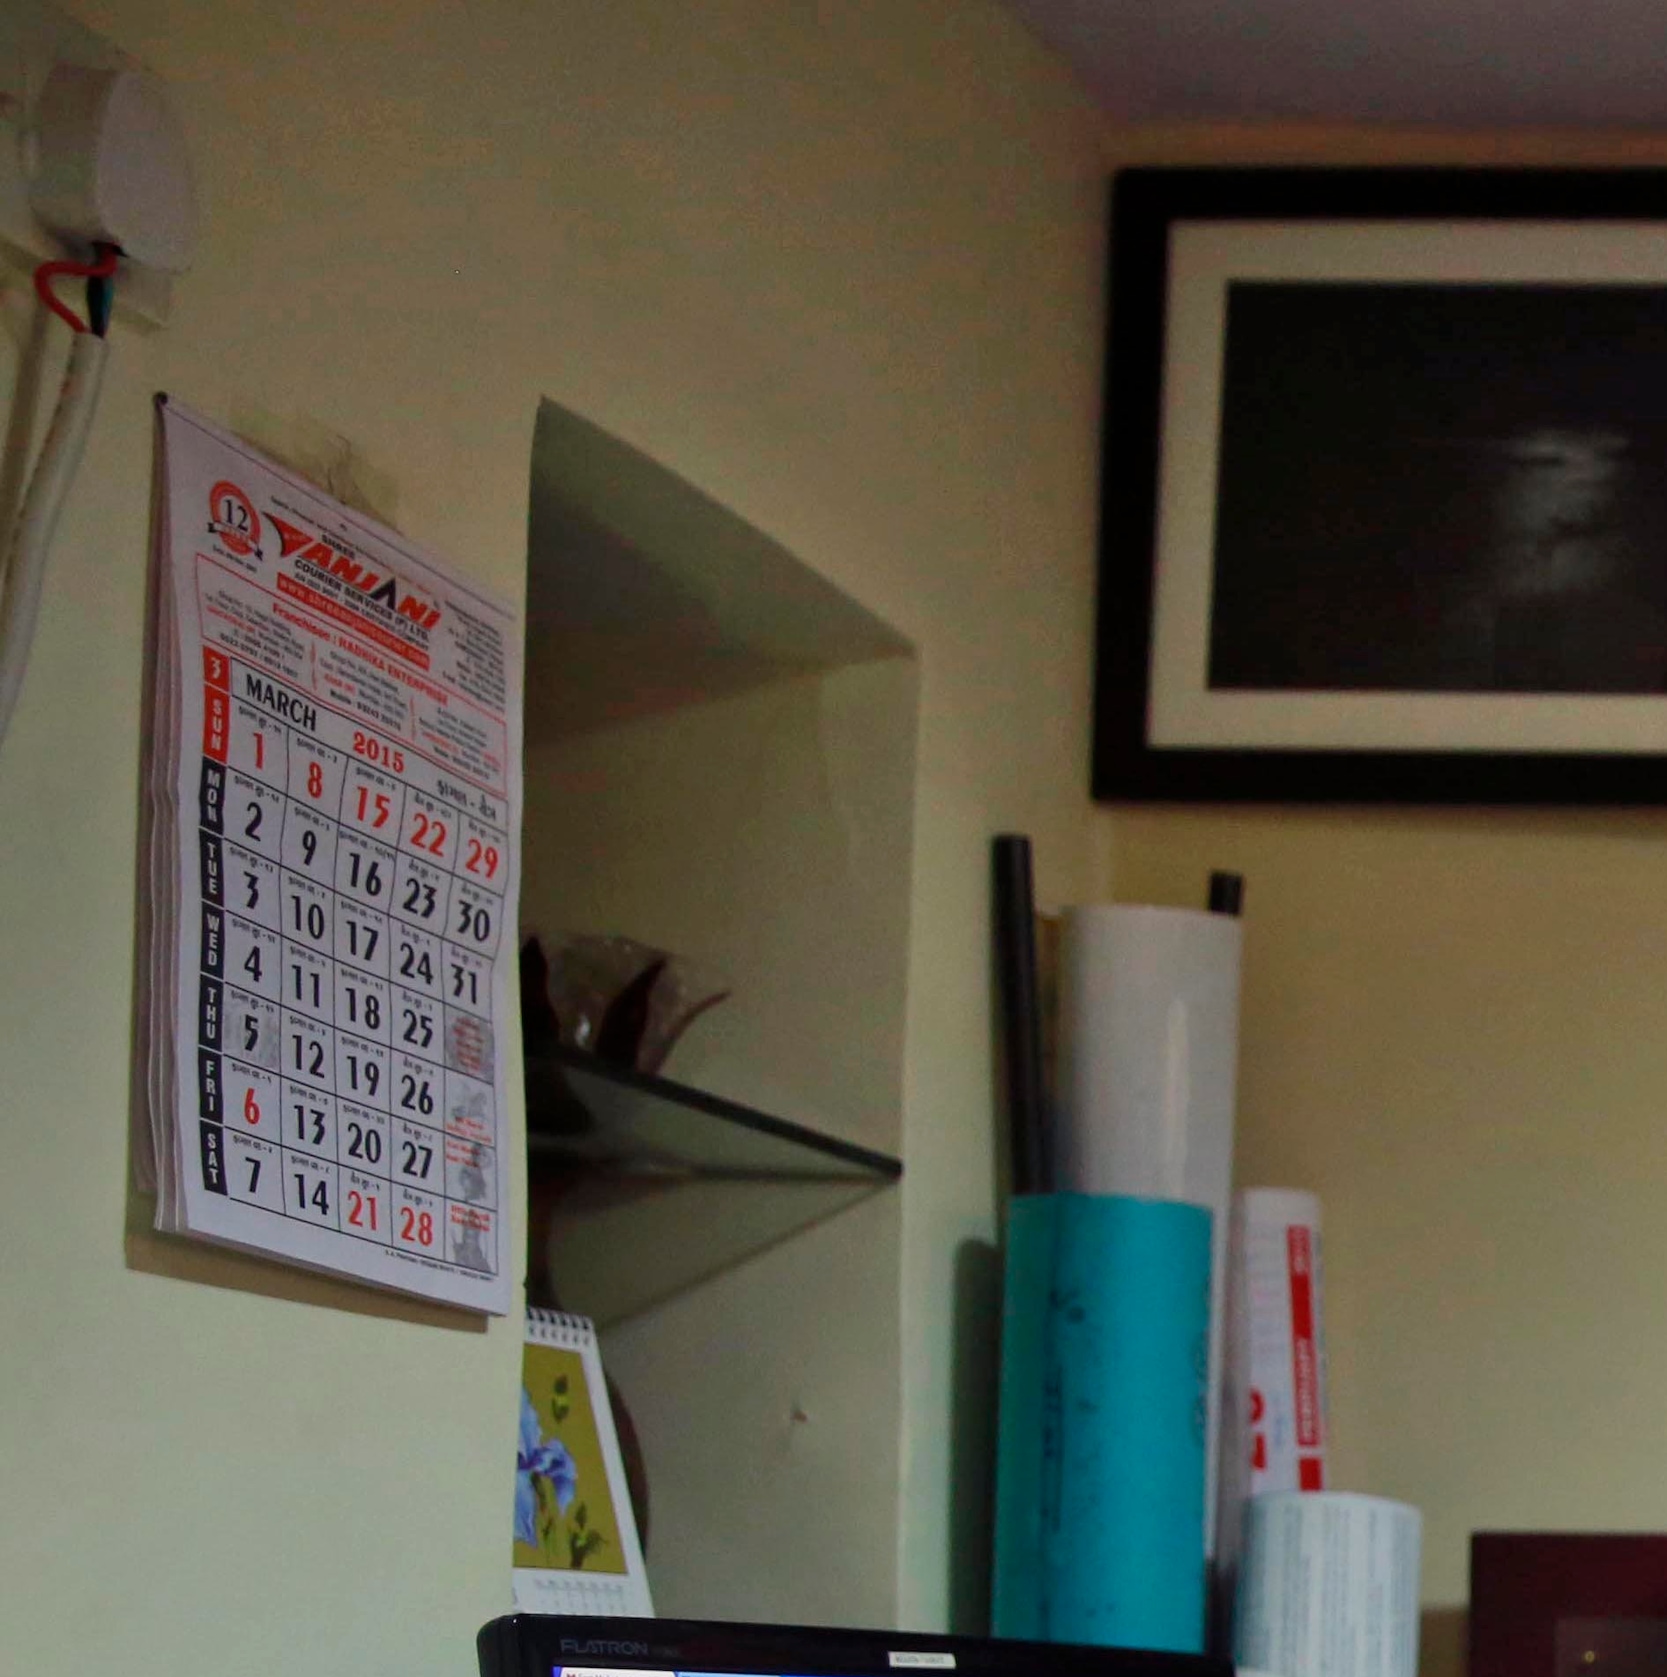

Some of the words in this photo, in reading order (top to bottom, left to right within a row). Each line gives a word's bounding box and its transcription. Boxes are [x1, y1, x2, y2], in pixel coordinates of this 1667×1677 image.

[225, 499, 249, 532] 12
[294, 560, 342, 591] COURIER
[345, 586, 393, 620] SERVICES
[212, 657, 222, 680] 3
[211, 699, 222, 750] SUN
[246, 673, 317, 731] MARCH
[353, 731, 405, 773] 2015
[207, 769, 220, 823] MON
[253, 732, 264, 769] 1
[307, 761, 323, 799] 8
[357, 786, 391, 828] 15
[410, 812, 447, 858] 22
[465, 838, 499, 879] 29
[207, 842, 218, 895] TUE
[245, 802, 263, 842] 2
[302, 830, 317, 866] 9
[349, 852, 382, 896] 16
[402, 877, 437, 919] 23
[457, 899, 490, 942] 30
[206, 913, 220, 966] WED
[243, 871, 260, 910] 3
[291, 895, 325, 940] 10
[346, 920, 379, 961] 17
[399, 942, 434, 985] 24
[450, 963, 477, 1005] 31
[206, 987, 217, 1038] THU
[244, 946, 263, 982] 4
[291, 964, 320, 1008] 11
[345, 987, 380, 1030] 18
[402, 1008, 433, 1049] 25
[206, 1060, 216, 1112] FRI
[244, 1014, 259, 1052] 5
[292, 1034, 325, 1079] 12
[346, 1055, 380, 1097] 19
[401, 1074, 434, 1115] 26
[207, 1133, 218, 1184] SAT
[244, 1087, 261, 1125] 6
[294, 1104, 326, 1145] 13
[347, 1122, 382, 1164] 20
[401, 1140, 433, 1179] 27
[245, 1156, 261, 1193] 7
[294, 1173, 329, 1216] 14
[347, 1190, 377, 1231] 21
[400, 1206, 434, 1247] 28
[560, 1638, 649, 1655] FLATRON
